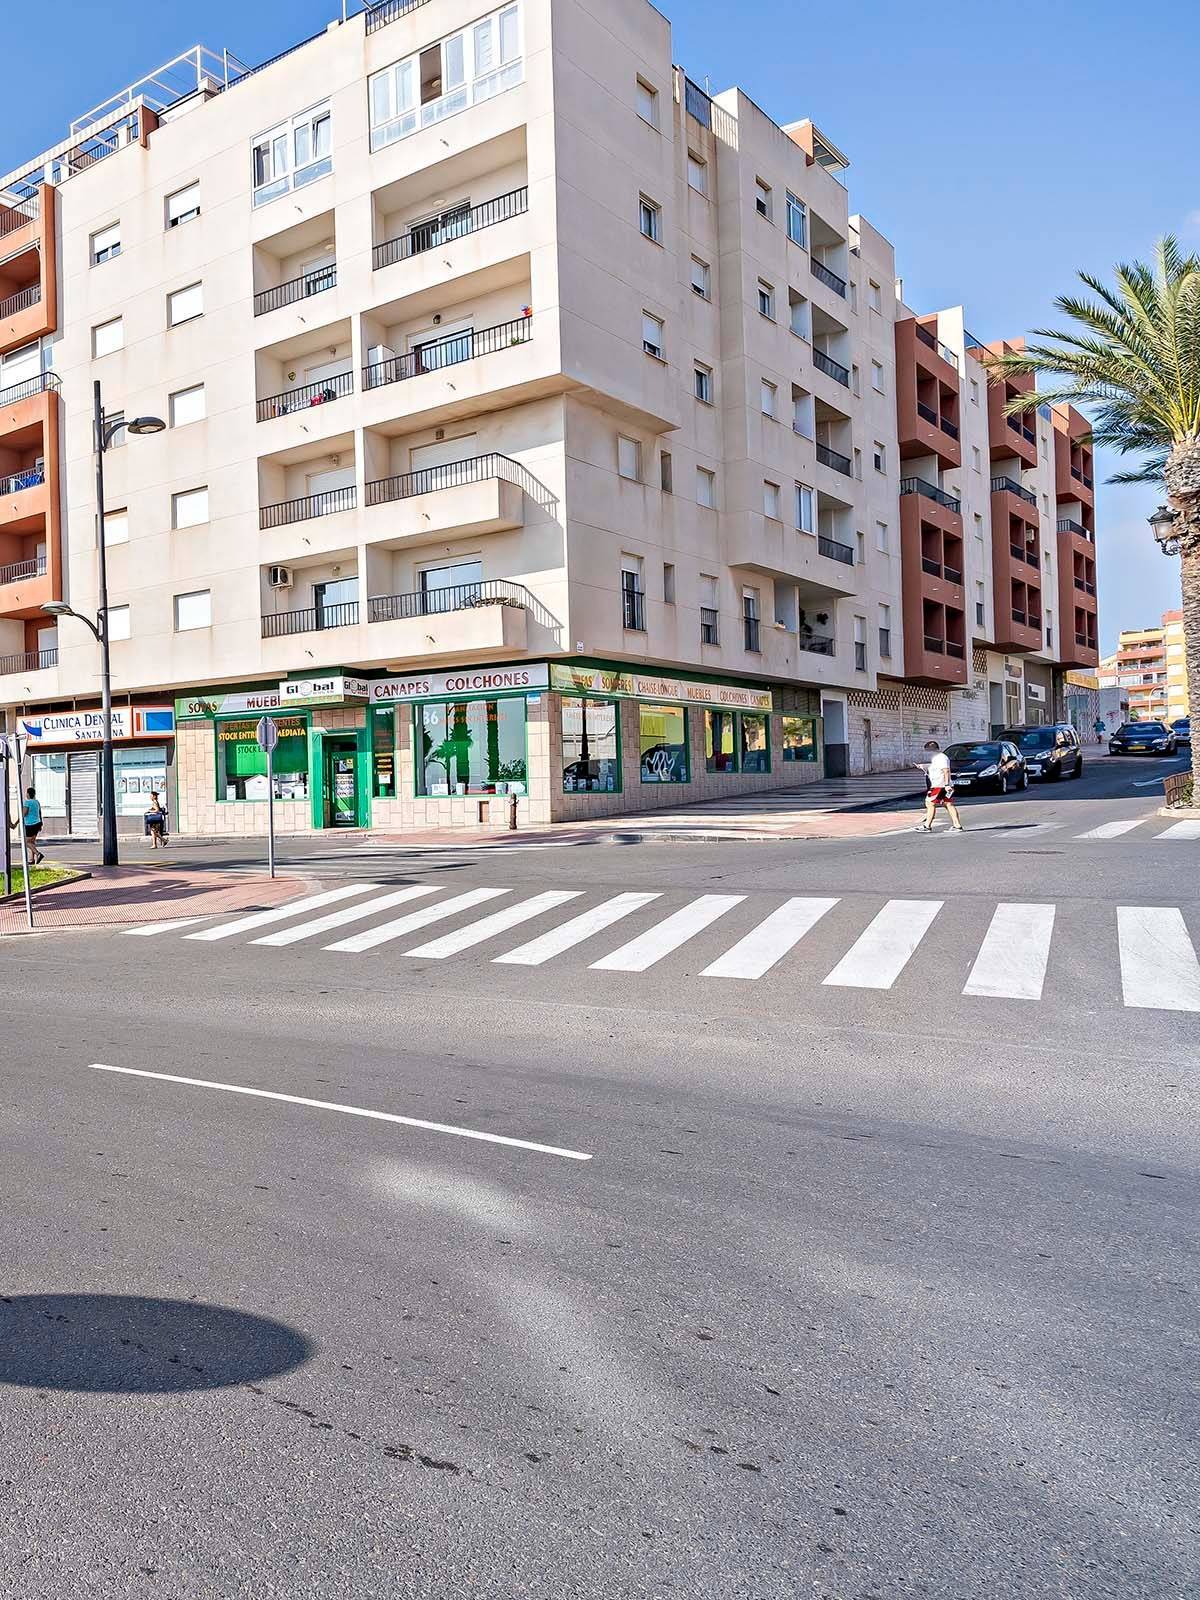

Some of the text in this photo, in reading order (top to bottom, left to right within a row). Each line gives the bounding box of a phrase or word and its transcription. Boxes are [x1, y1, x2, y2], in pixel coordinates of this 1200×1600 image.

[374, 671, 529, 698] CANAPES COLCHONES
[687, 687, 711, 700] MUEBLES
[43, 713, 124, 730] CLINICA DENAL
[75, 730, 102, 740] SANTA
[219, 732, 239, 741] STOCK
[238, 745, 256, 754] STOCK
